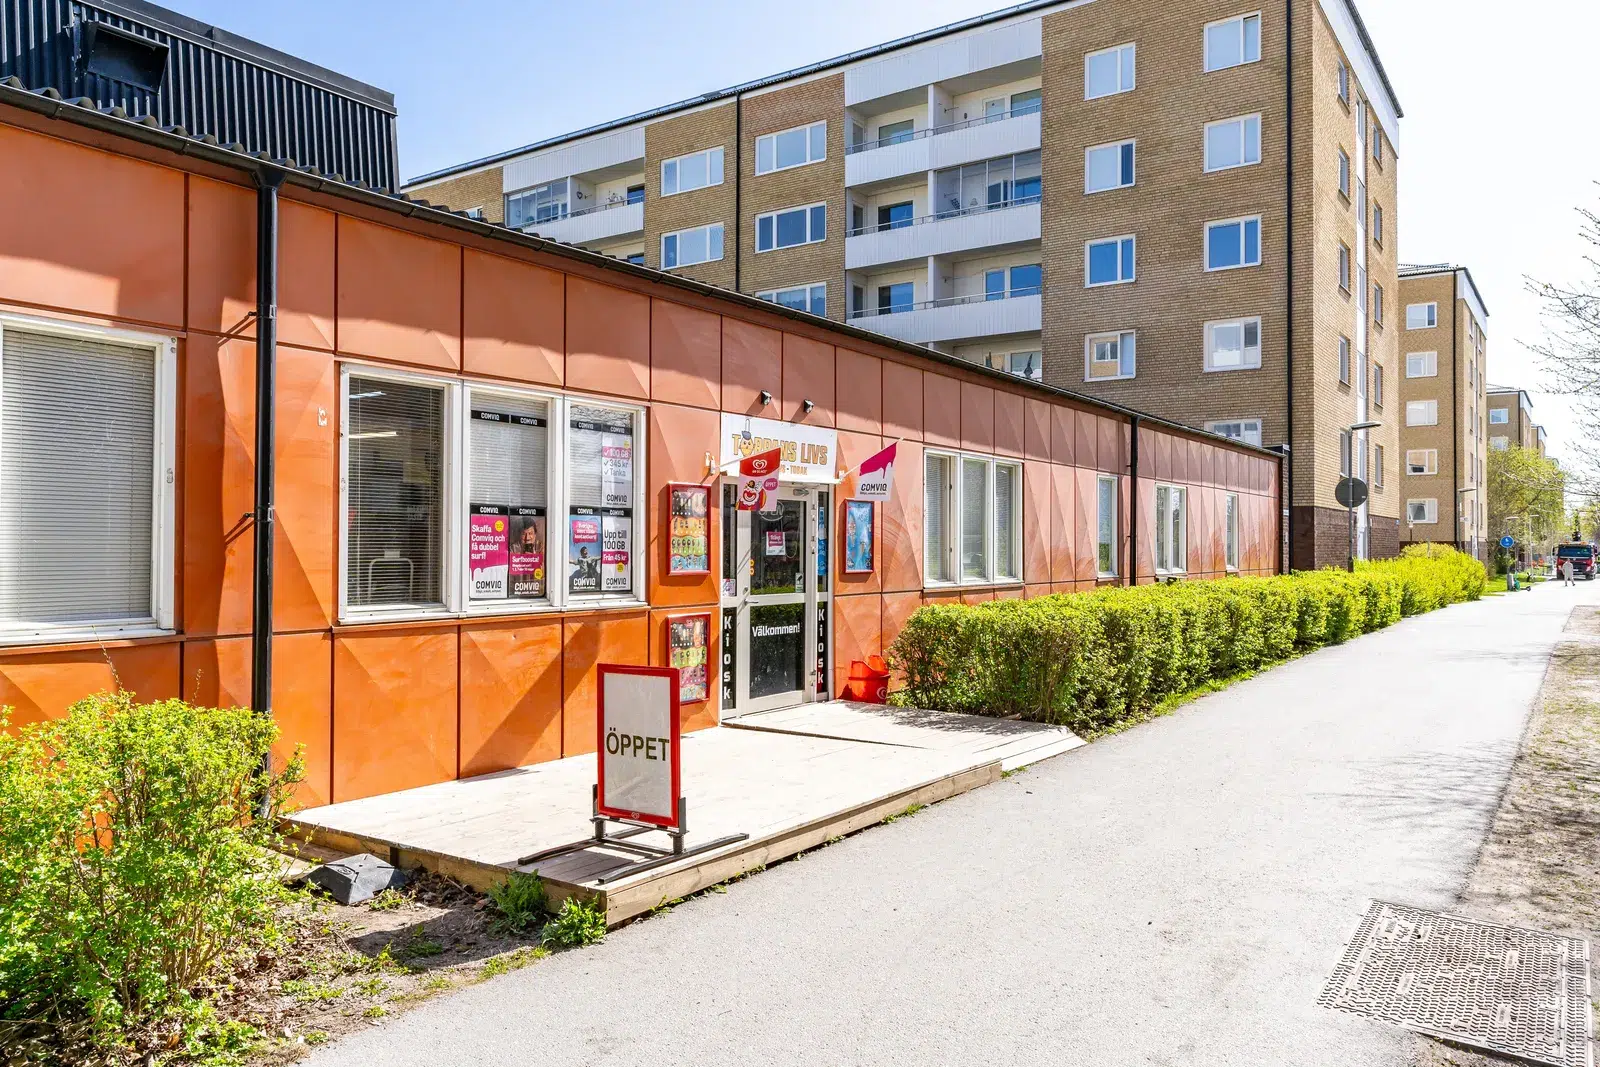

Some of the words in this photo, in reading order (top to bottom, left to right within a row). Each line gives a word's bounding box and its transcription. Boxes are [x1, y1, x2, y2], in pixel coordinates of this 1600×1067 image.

[480, 412, 500, 421] COMVIQ
[520, 417, 538, 426] COMVIQ
[800, 442, 828, 466] LIVS
[861, 483, 888, 492] COMVIQ
[606, 494, 628, 503] COMVIQ
[480, 506, 499, 514] COMVIQ
[471, 524, 492, 533] Skaffa
[471, 533, 494, 543] Comviq
[494, 534, 506, 542] och
[604, 530, 617, 540] Upp
[617, 530, 627, 539] till
[471, 542, 478, 551] få
[478, 543, 499, 551] dubbel
[604, 541, 616, 550] 100
[616, 541, 626, 550] GB
[471, 552, 486, 560] surf!
[475, 580, 502, 589] COMVIQ
[573, 577, 596, 586] COMVIQ
[605, 578, 627, 586] COMVIQ
[514, 582, 540, 591] COMVIQ
[752, 622, 800, 637] Välkommen!
[817, 608, 825, 684] Kiosk
[723, 615, 732, 700] Kiosk
[606, 726, 670, 762] ÖPPET
